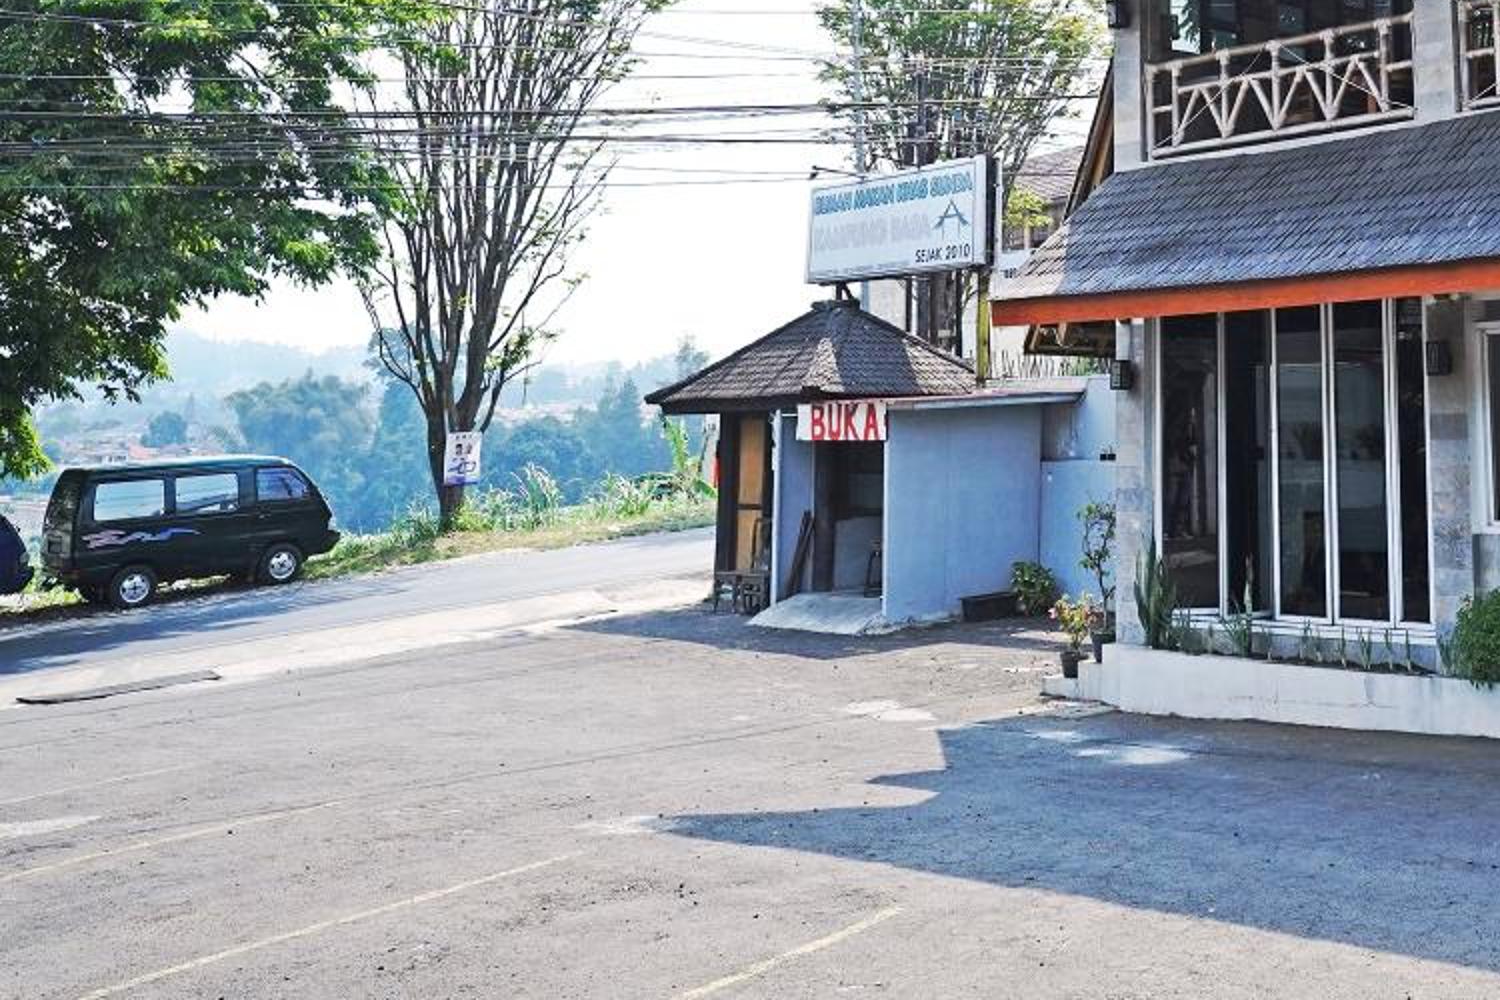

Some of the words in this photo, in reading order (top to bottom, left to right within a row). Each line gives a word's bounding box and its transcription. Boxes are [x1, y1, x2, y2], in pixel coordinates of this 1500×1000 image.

[915, 246, 943, 263] SEJAK
[945, 243, 971, 260] 2010
[811, 402, 880, 440] BUKA
